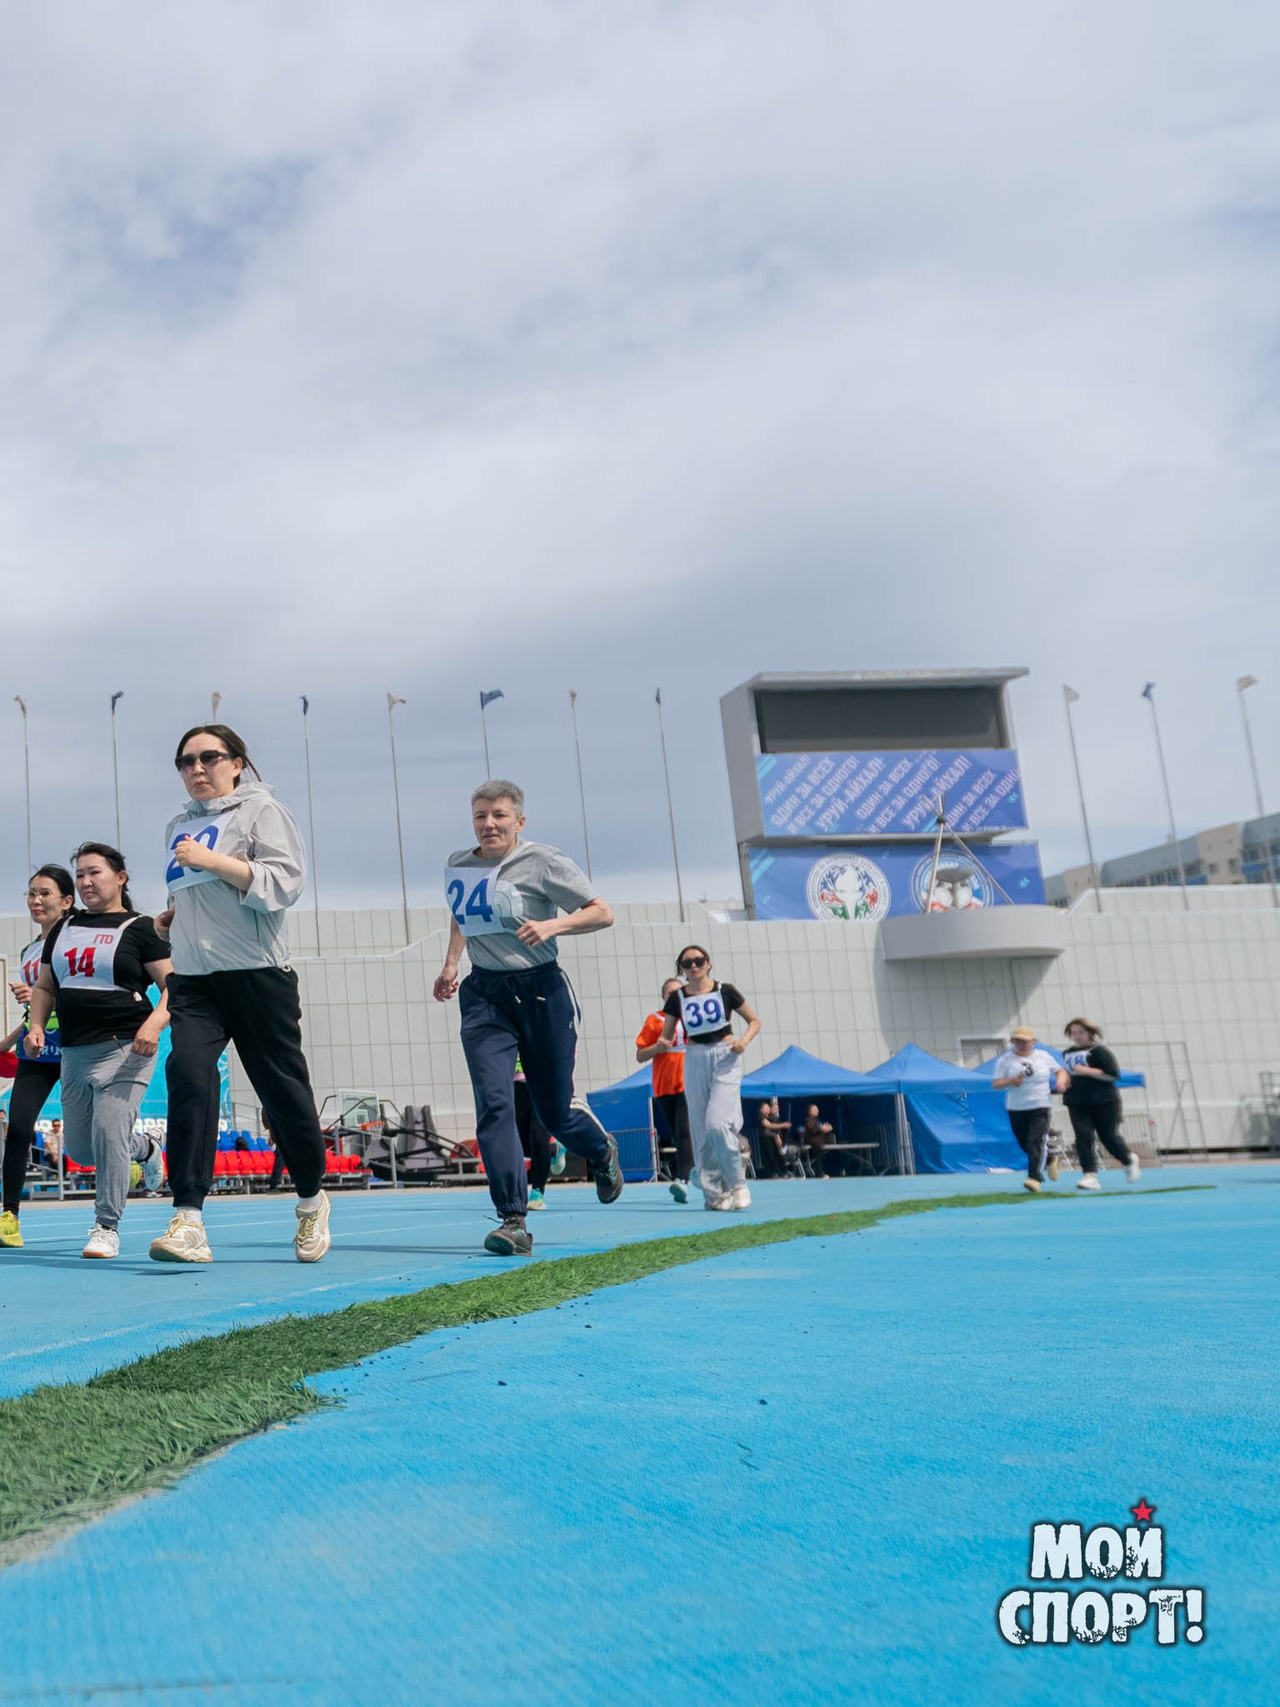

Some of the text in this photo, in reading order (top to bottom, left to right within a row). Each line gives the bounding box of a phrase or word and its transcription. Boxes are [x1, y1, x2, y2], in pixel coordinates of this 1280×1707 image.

[771, 756, 835, 826] ОДИН ЗА ВСЕХ
[787, 755, 860, 834] И ВСЕ ЗА ОДНОГО!
[815, 757, 886, 832] УРУЙ-АЙХАЛ!
[856, 757, 913, 819] ОДИН ЗА ВСЕХ
[876, 806, 896, 829] ВСЕ
[891, 794, 908, 811] ЗА
[902, 755, 941, 798] ОДНОГО!
[962, 792, 979, 808] ЗА
[973, 768, 998, 795] ВСЕХ
[969, 804, 990, 826] ВСЕ
[984, 793, 1000, 809] ЗА
[447, 878, 494, 925] 24
[93, 933, 114, 944] ГТО
[22, 957, 41, 986] 11
[64, 947, 96, 977] 14
[685, 998, 721, 1028] 39
